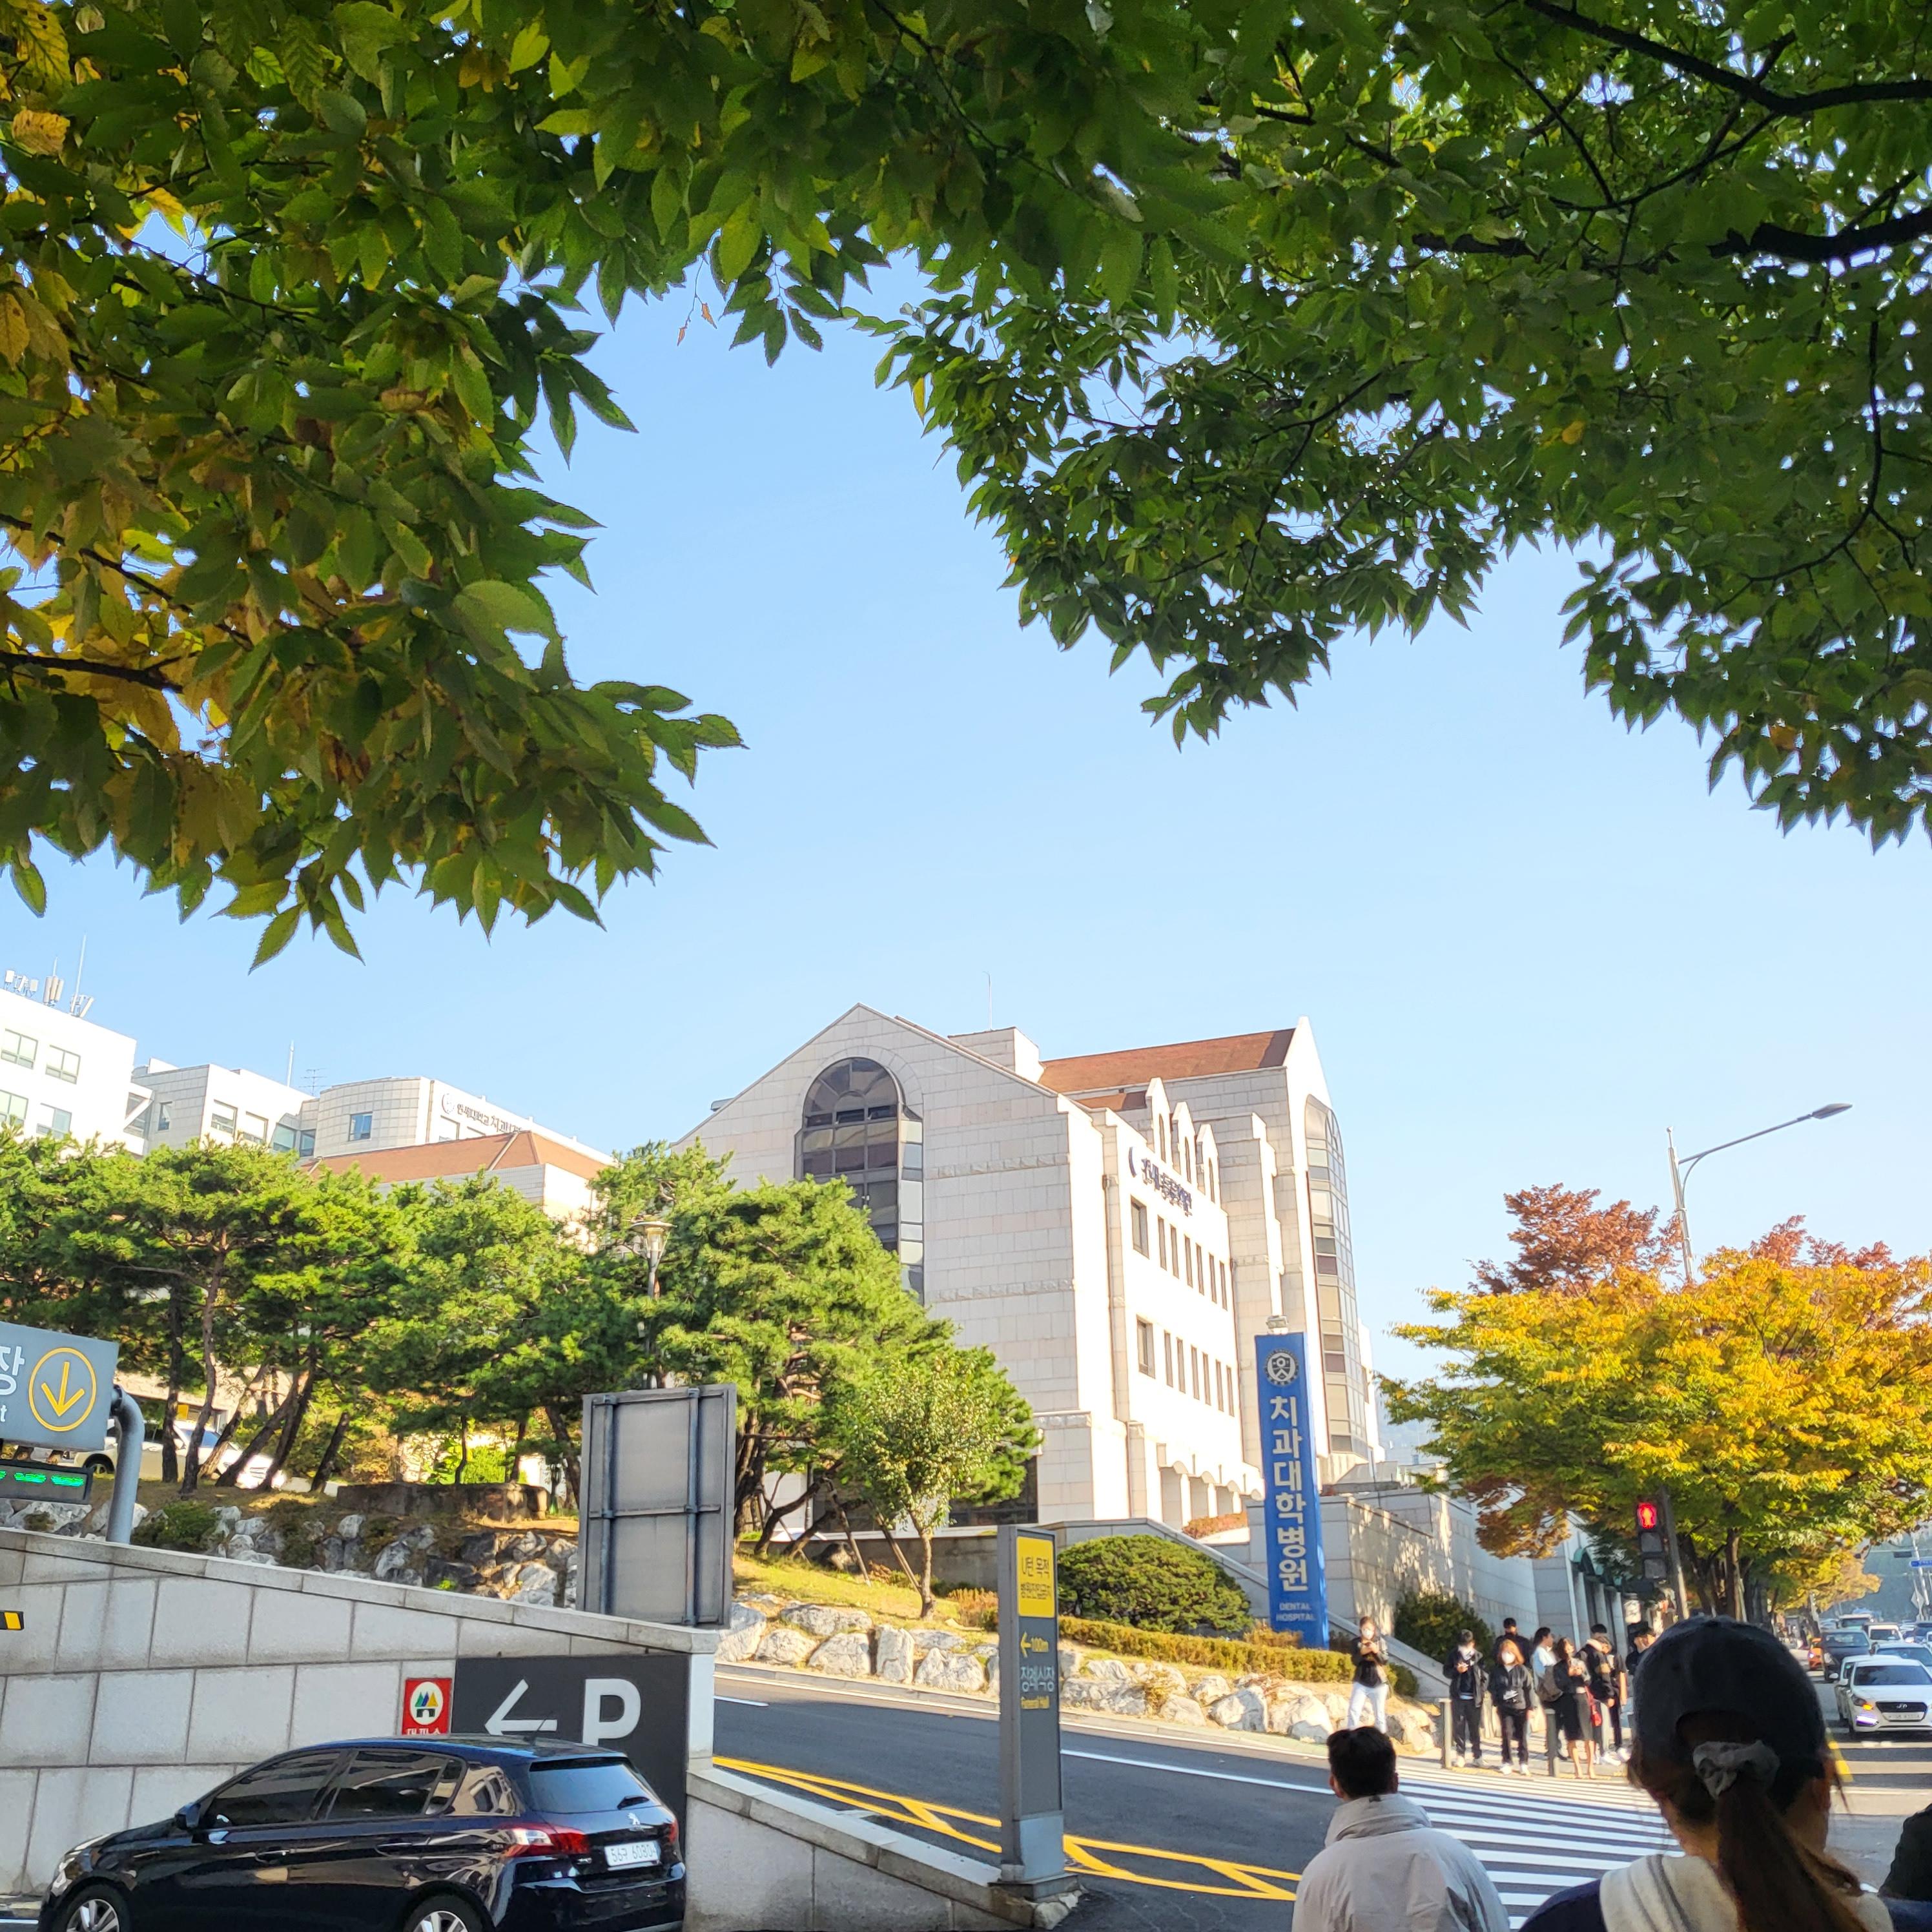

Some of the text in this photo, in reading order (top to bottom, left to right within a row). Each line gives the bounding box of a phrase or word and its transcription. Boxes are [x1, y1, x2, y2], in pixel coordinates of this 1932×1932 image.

[1269, 1395, 1309, 1592] 치과대학병원
[1276, 1613, 1316, 1621] HOSPITAL
[1279, 1602, 1311, 1611] DENTAL
[1020, 1665, 1054, 1692] 장례식장
[584, 1678, 641, 1746] P
